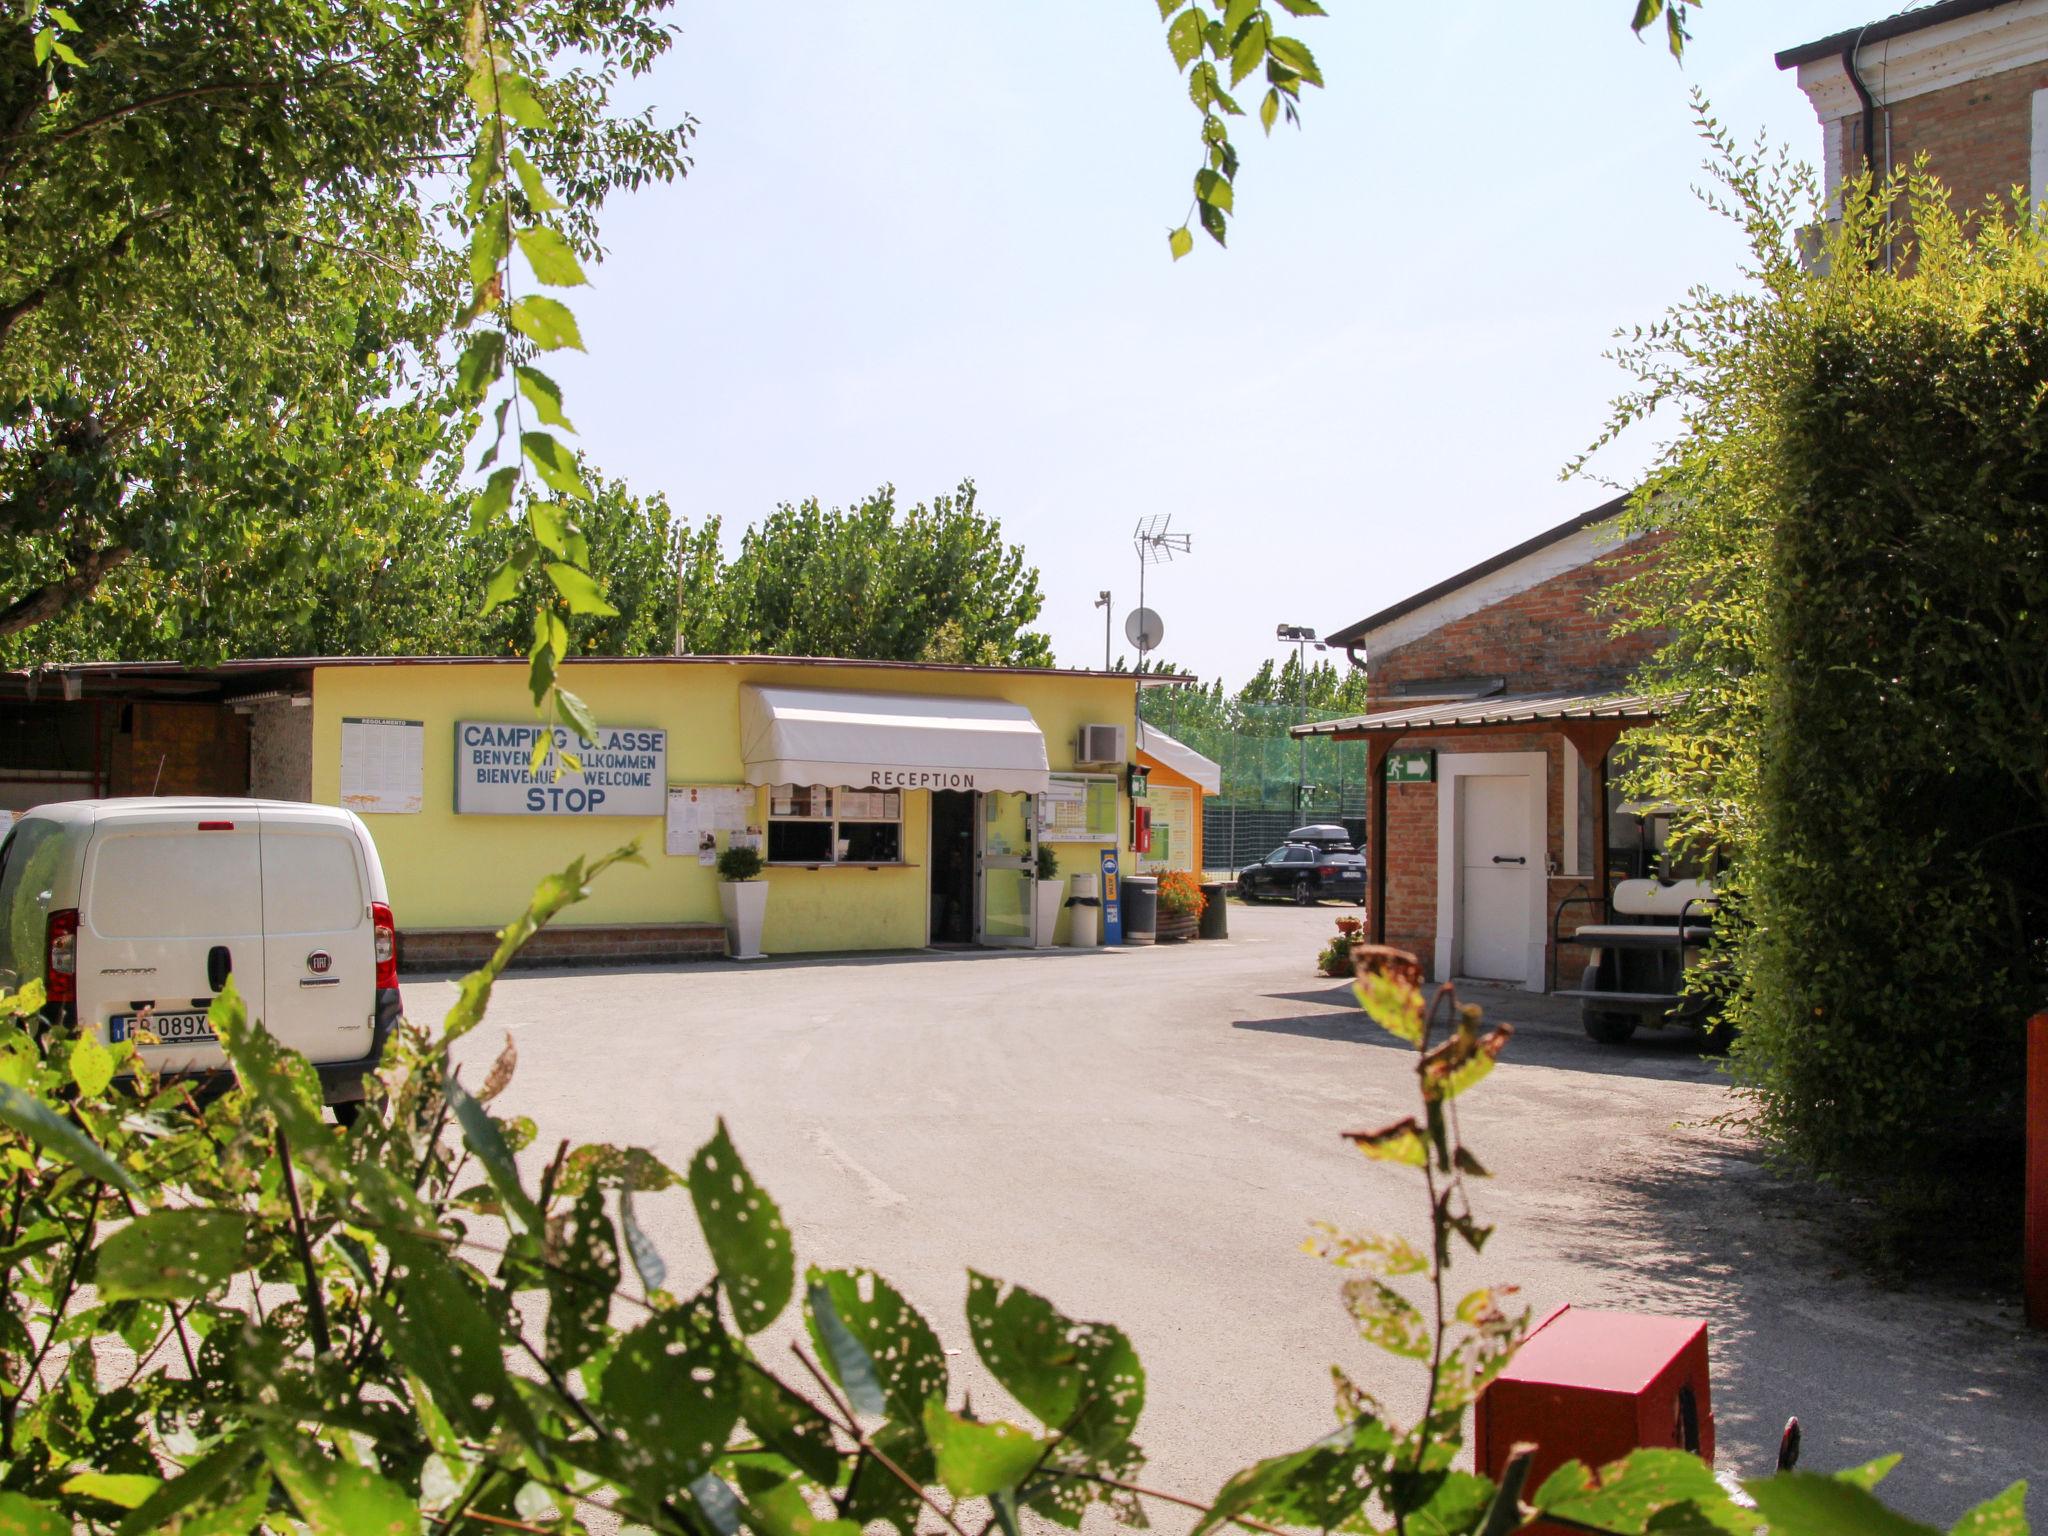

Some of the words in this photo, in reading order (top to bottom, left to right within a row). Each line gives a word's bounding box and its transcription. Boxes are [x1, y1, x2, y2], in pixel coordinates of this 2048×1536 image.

[361, 718, 406, 726] REGOLAMENTO
[473, 749, 553, 767] BENVENTI
[584, 772, 651, 786] WELCOME
[871, 771, 974, 787] RECEPTION
[526, 787, 606, 812] STOP
[313, 957, 327, 969] FIAT
